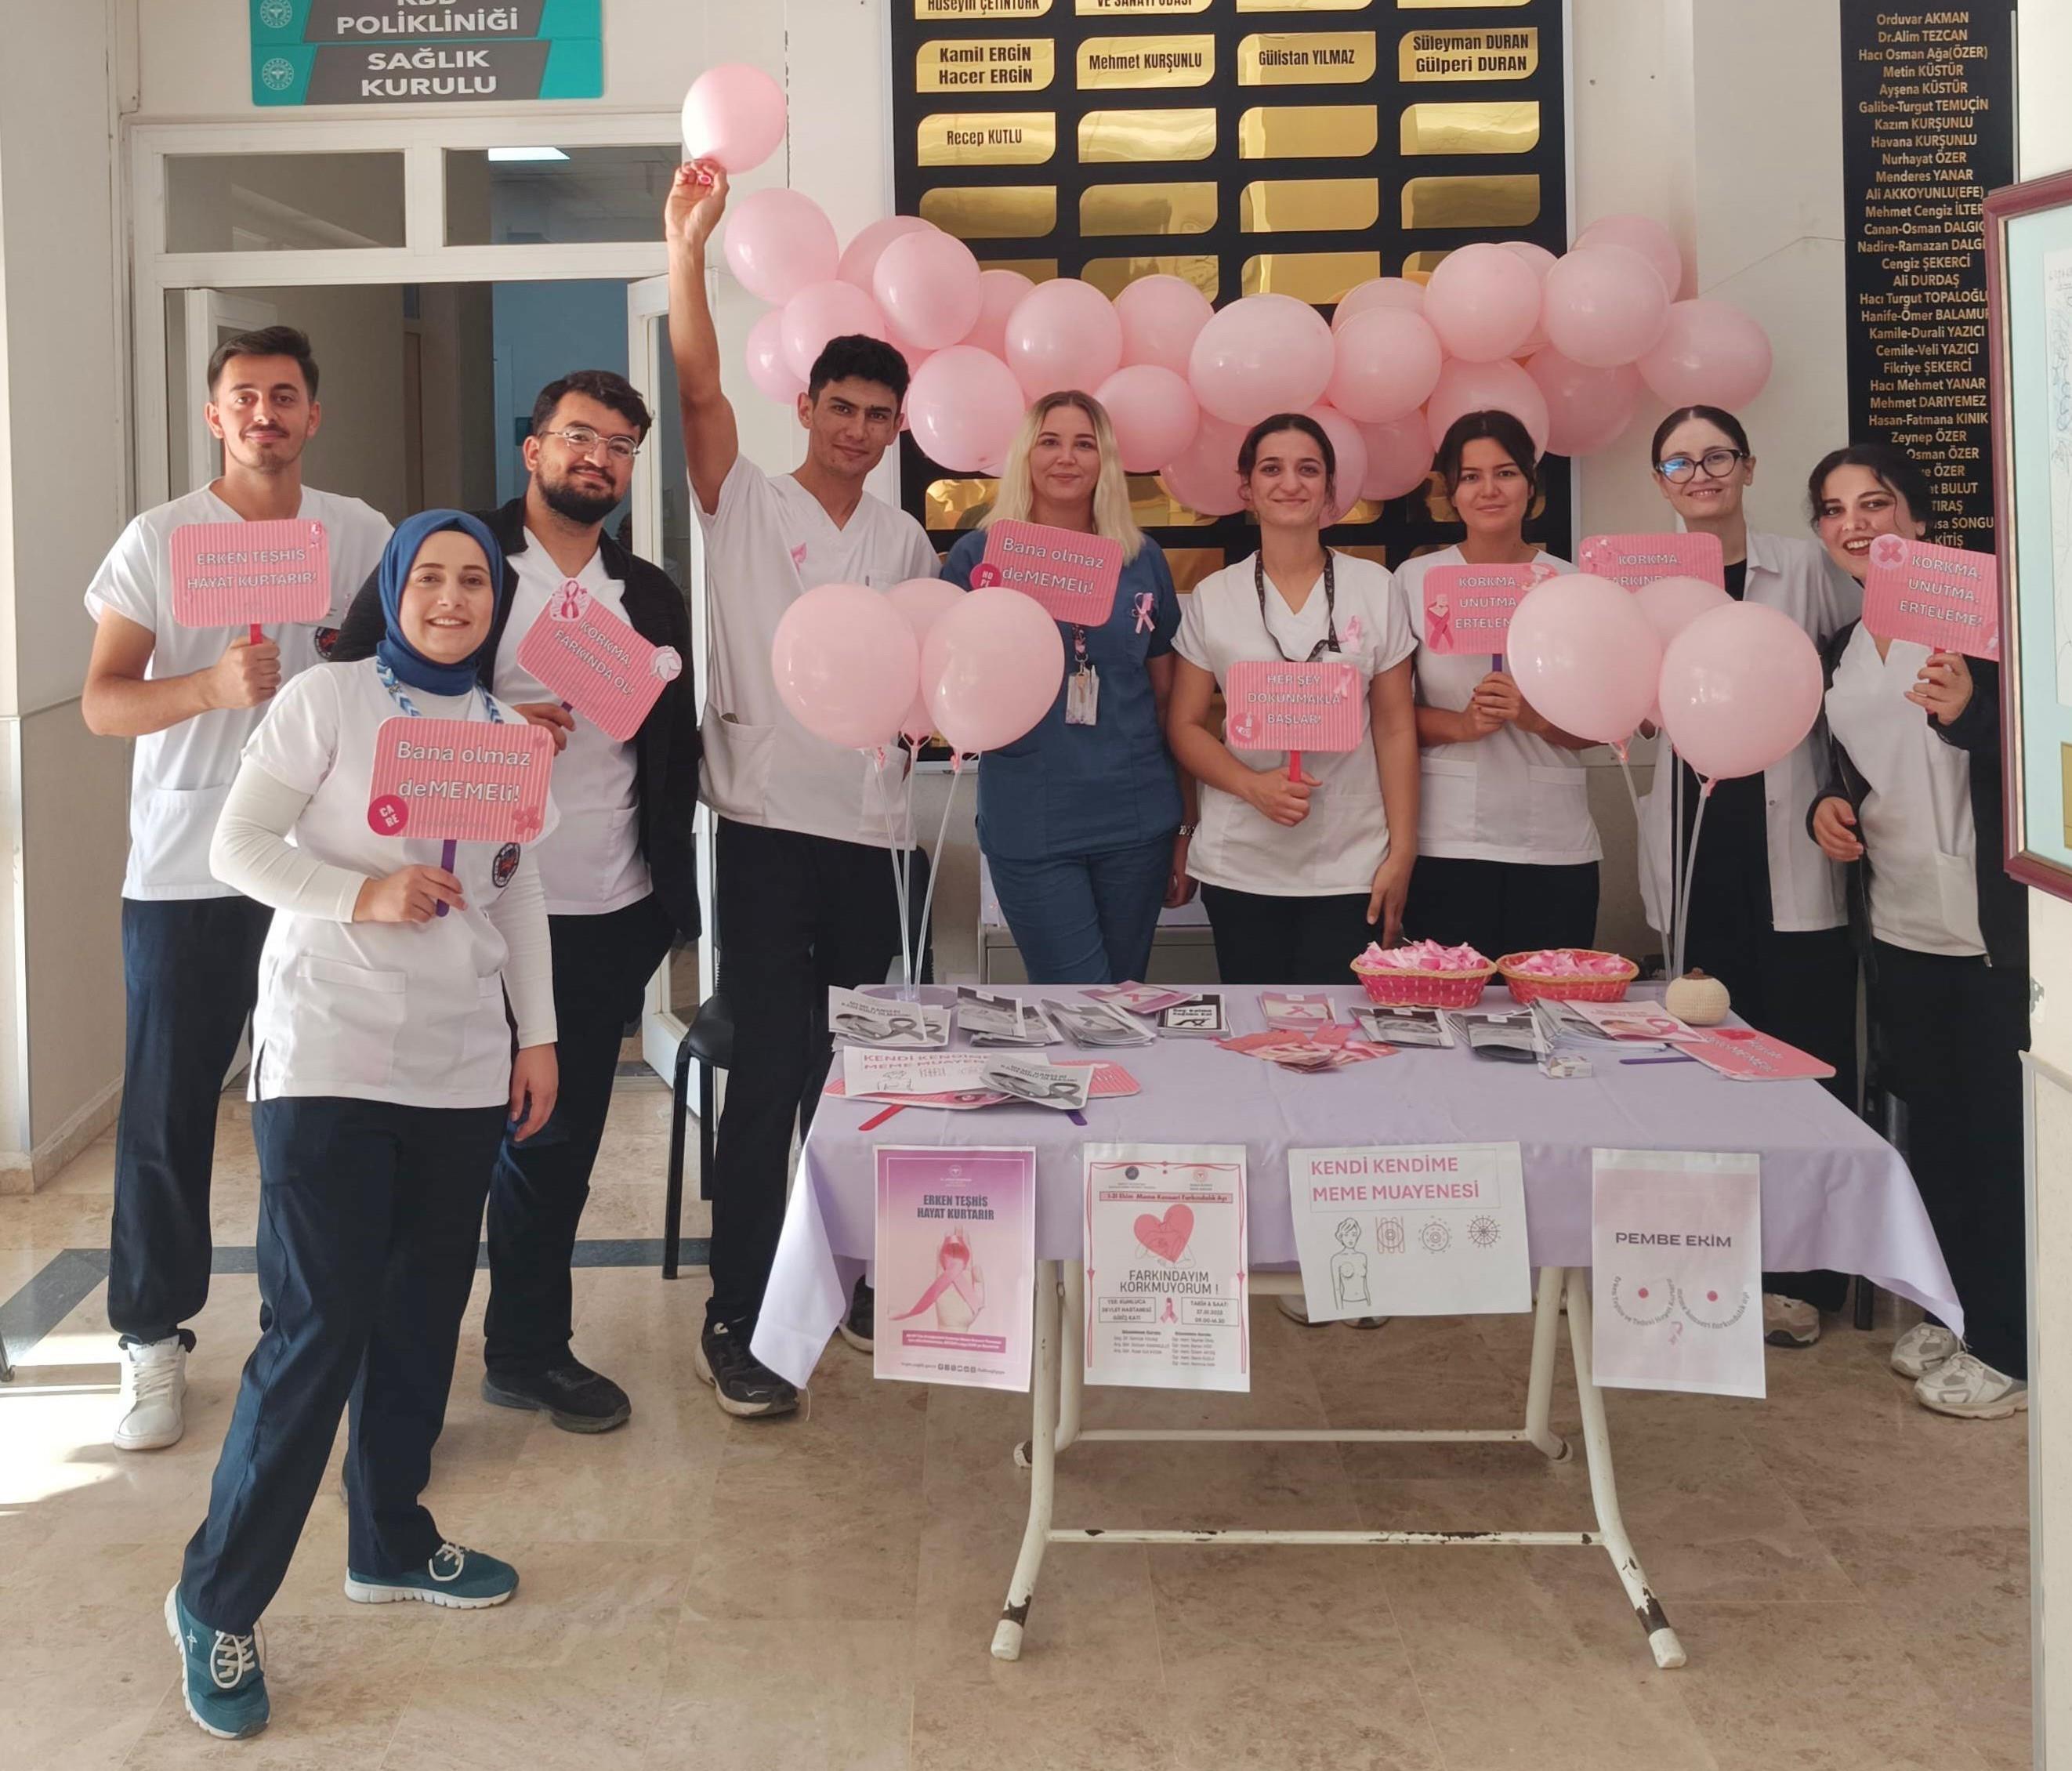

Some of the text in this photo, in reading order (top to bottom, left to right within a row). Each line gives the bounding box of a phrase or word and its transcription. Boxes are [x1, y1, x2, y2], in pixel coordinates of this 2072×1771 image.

[337, 7, 518, 34] POLİKLİNİĞİ
[1877, 12, 1969, 25] Orduvar AKMAN
[1413, 34, 1529, 53] Süleyman DURAN
[1878, 29, 1968, 43] Dr.Alim TEZCAN
[367, 48, 491, 71] SAĞLIK
[940, 44, 1031, 63] Kamil ERGİN
[1259, 49, 1355, 67] Gülistan YILMAZ
[1859, 44, 1988, 62] Hacı Osman Ağa(ÖZER)
[1089, 53, 1202, 74] Mehmet KURŞUNLU
[1415, 56, 1527, 74] Gülperi DURAN
[1883, 62, 1965, 78] Metin KÜSTÜR
[939, 66, 1033, 85] Hacer ERGİN
[361, 76, 498, 97] KURULU
[1879, 79, 1968, 98] Ayşena KÜSTÜR
[1859, 96, 1989, 115] Galibe-Turgut TEMUÇİN
[1875, 116, 1973, 132] Kazım KURŞUNLU
[947, 129, 1023, 147] Recep KUTLU
[1871, 134, 1977, 150] Havana KURŞUNLU
[1882, 149, 1967, 166] Nurhayat ÖZER
[1876, 168, 1974, 183] Menderes YANAR
[1866, 186, 1984, 201] Ali AKKOYUNLU(EFE)
[1865, 205, 1912, 218] Mehmet
[1914, 204, 1952, 219] Cengiz
[1864, 223, 1941, 235] Canan-Osman
[1858, 240, 1950, 252] Nadire-Ramazan
[1882, 253, 1971, 272] Cengiz ŞEKERCİ
[1893, 273, 1960, 288] Ali DURDAŞ
[1860, 293, 1883, 306] Hacı
[1885, 293, 1922, 307] Turgut
[1861, 306, 1933, 322] Hanife-Ömer
[1869, 325, 1985, 340] Kamile-Durali YAZICI
[1876, 342, 1979, 357] Cemile-Veli YAZICI
[1883, 357, 1972, 376] Fikriye ŞEKERCİ
[1870, 377, 1986, 392] Hacı Mehmet YANAR
[1870, 395, 1987, 409] Mehmet DARIYEMEZ
[1868, 412, 1988, 427] Hasan-Fatmana KINIK
[1891, 428, 1967, 446] Zeynep ÖZER
[1948, 445, 1980, 459] ÖZER
[1933, 462, 1965, 476] ÖZER
[1941, 482, 1978, 494] BULUT
[197, 552, 248, 565] ERKEN
[1002, 538, 1105, 570] Bana olmaz
[187, 575, 234, 590] HAYAT
[1002, 567, 1095, 596] deMEMEli!
[555, 629, 613, 681] FARKINDA
[1267, 674, 1293, 685] HER
[1248, 692, 1341, 705] DOKUNMAKLA
[397, 741, 532, 766] Bana olmaz
[398, 777, 522, 802] deMEMEli!
[1311, 1154, 1458, 1175] KENDİ KENDİME
[1313, 1180, 1480, 1202] MEME MUAYENESİ
[923, 1193, 988, 1208] ERKEN TEŞHİS
[917, 1208, 994, 1221] HAYAT KURTARIR
[1616, 1232, 1732, 1248] PEMBE EKİM
[1129, 1269, 1209, 1283] FARKINDAYIM
[1120, 1281, 1212, 1295] KORKMUYORUM
